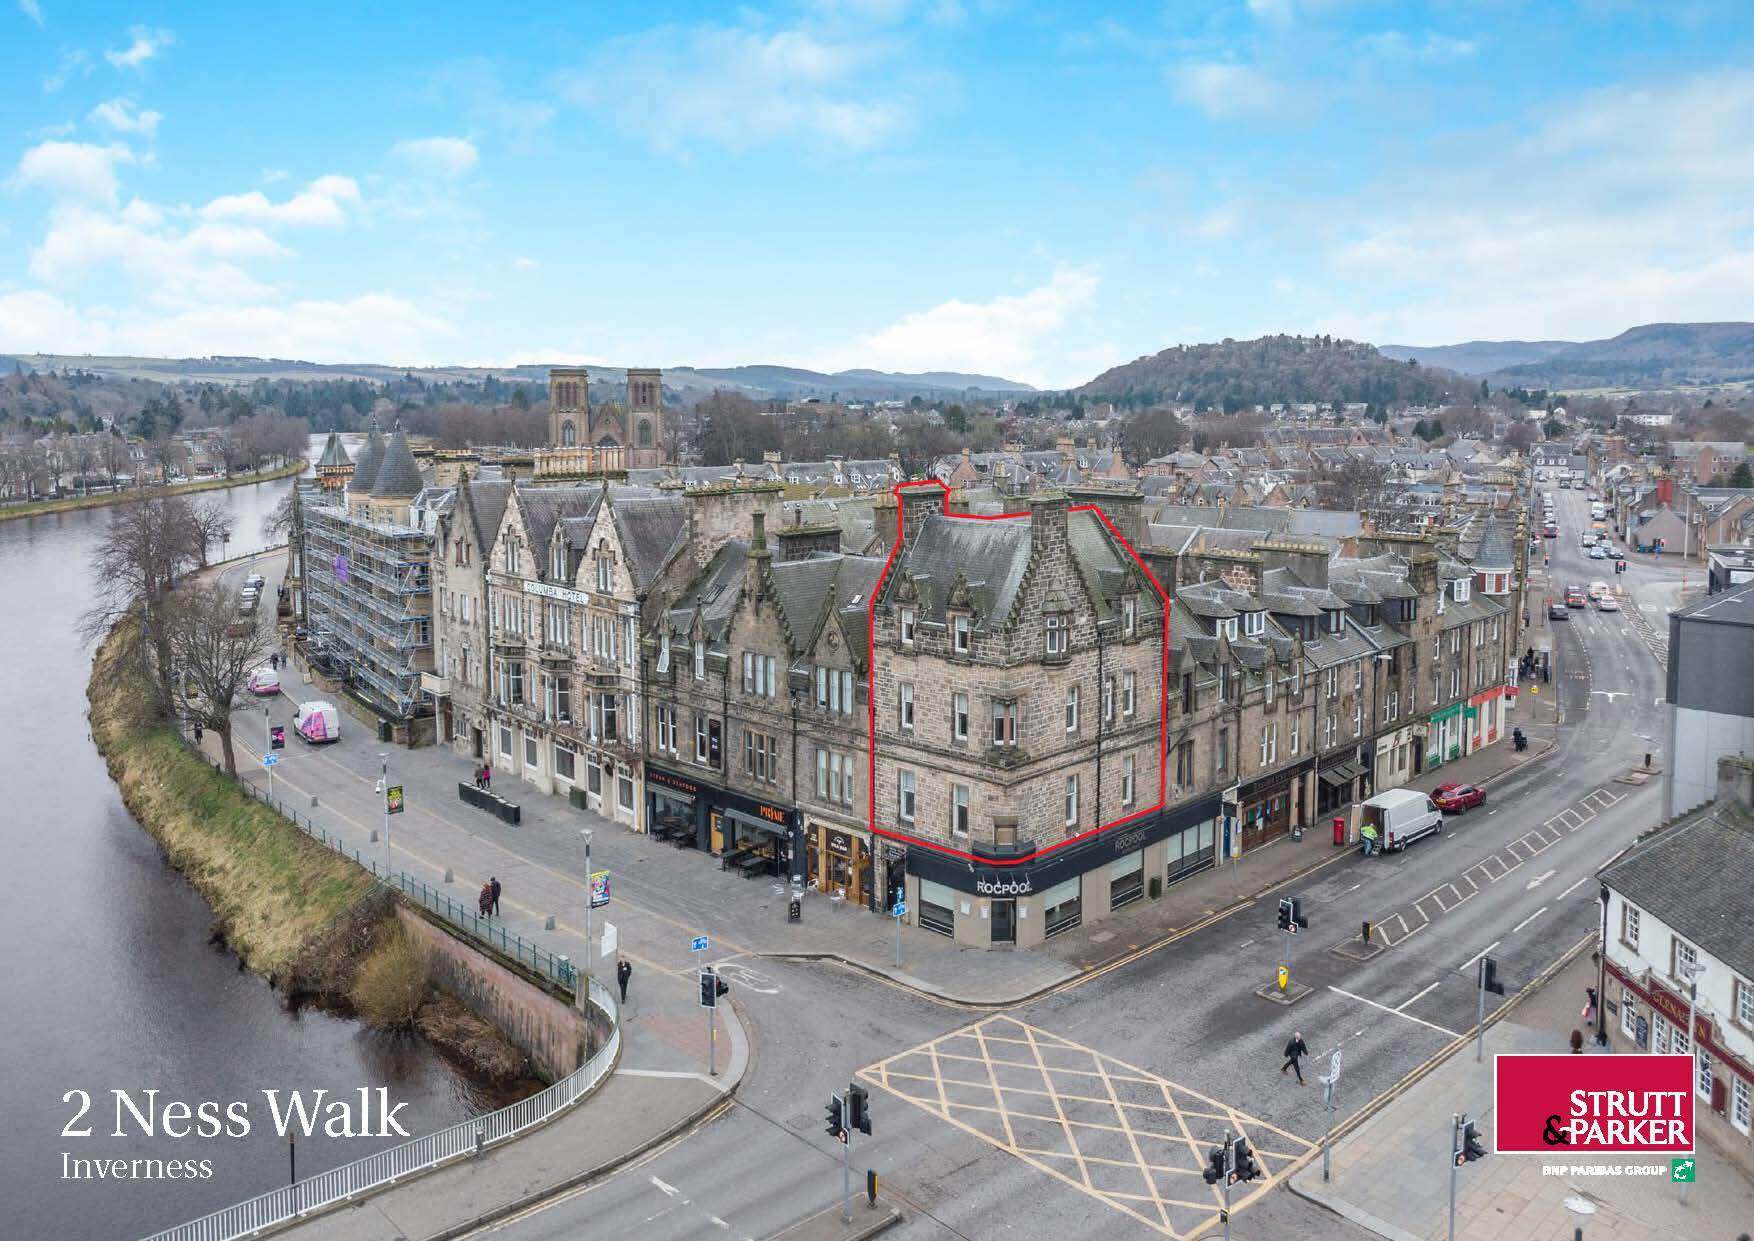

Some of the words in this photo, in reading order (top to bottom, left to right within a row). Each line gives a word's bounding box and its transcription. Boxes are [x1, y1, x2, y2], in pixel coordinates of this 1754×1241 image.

[527, 583, 557, 597] COLUMBA
[562, 590, 585, 603] HOTEL
[977, 880, 1032, 894] ROCPOOL
